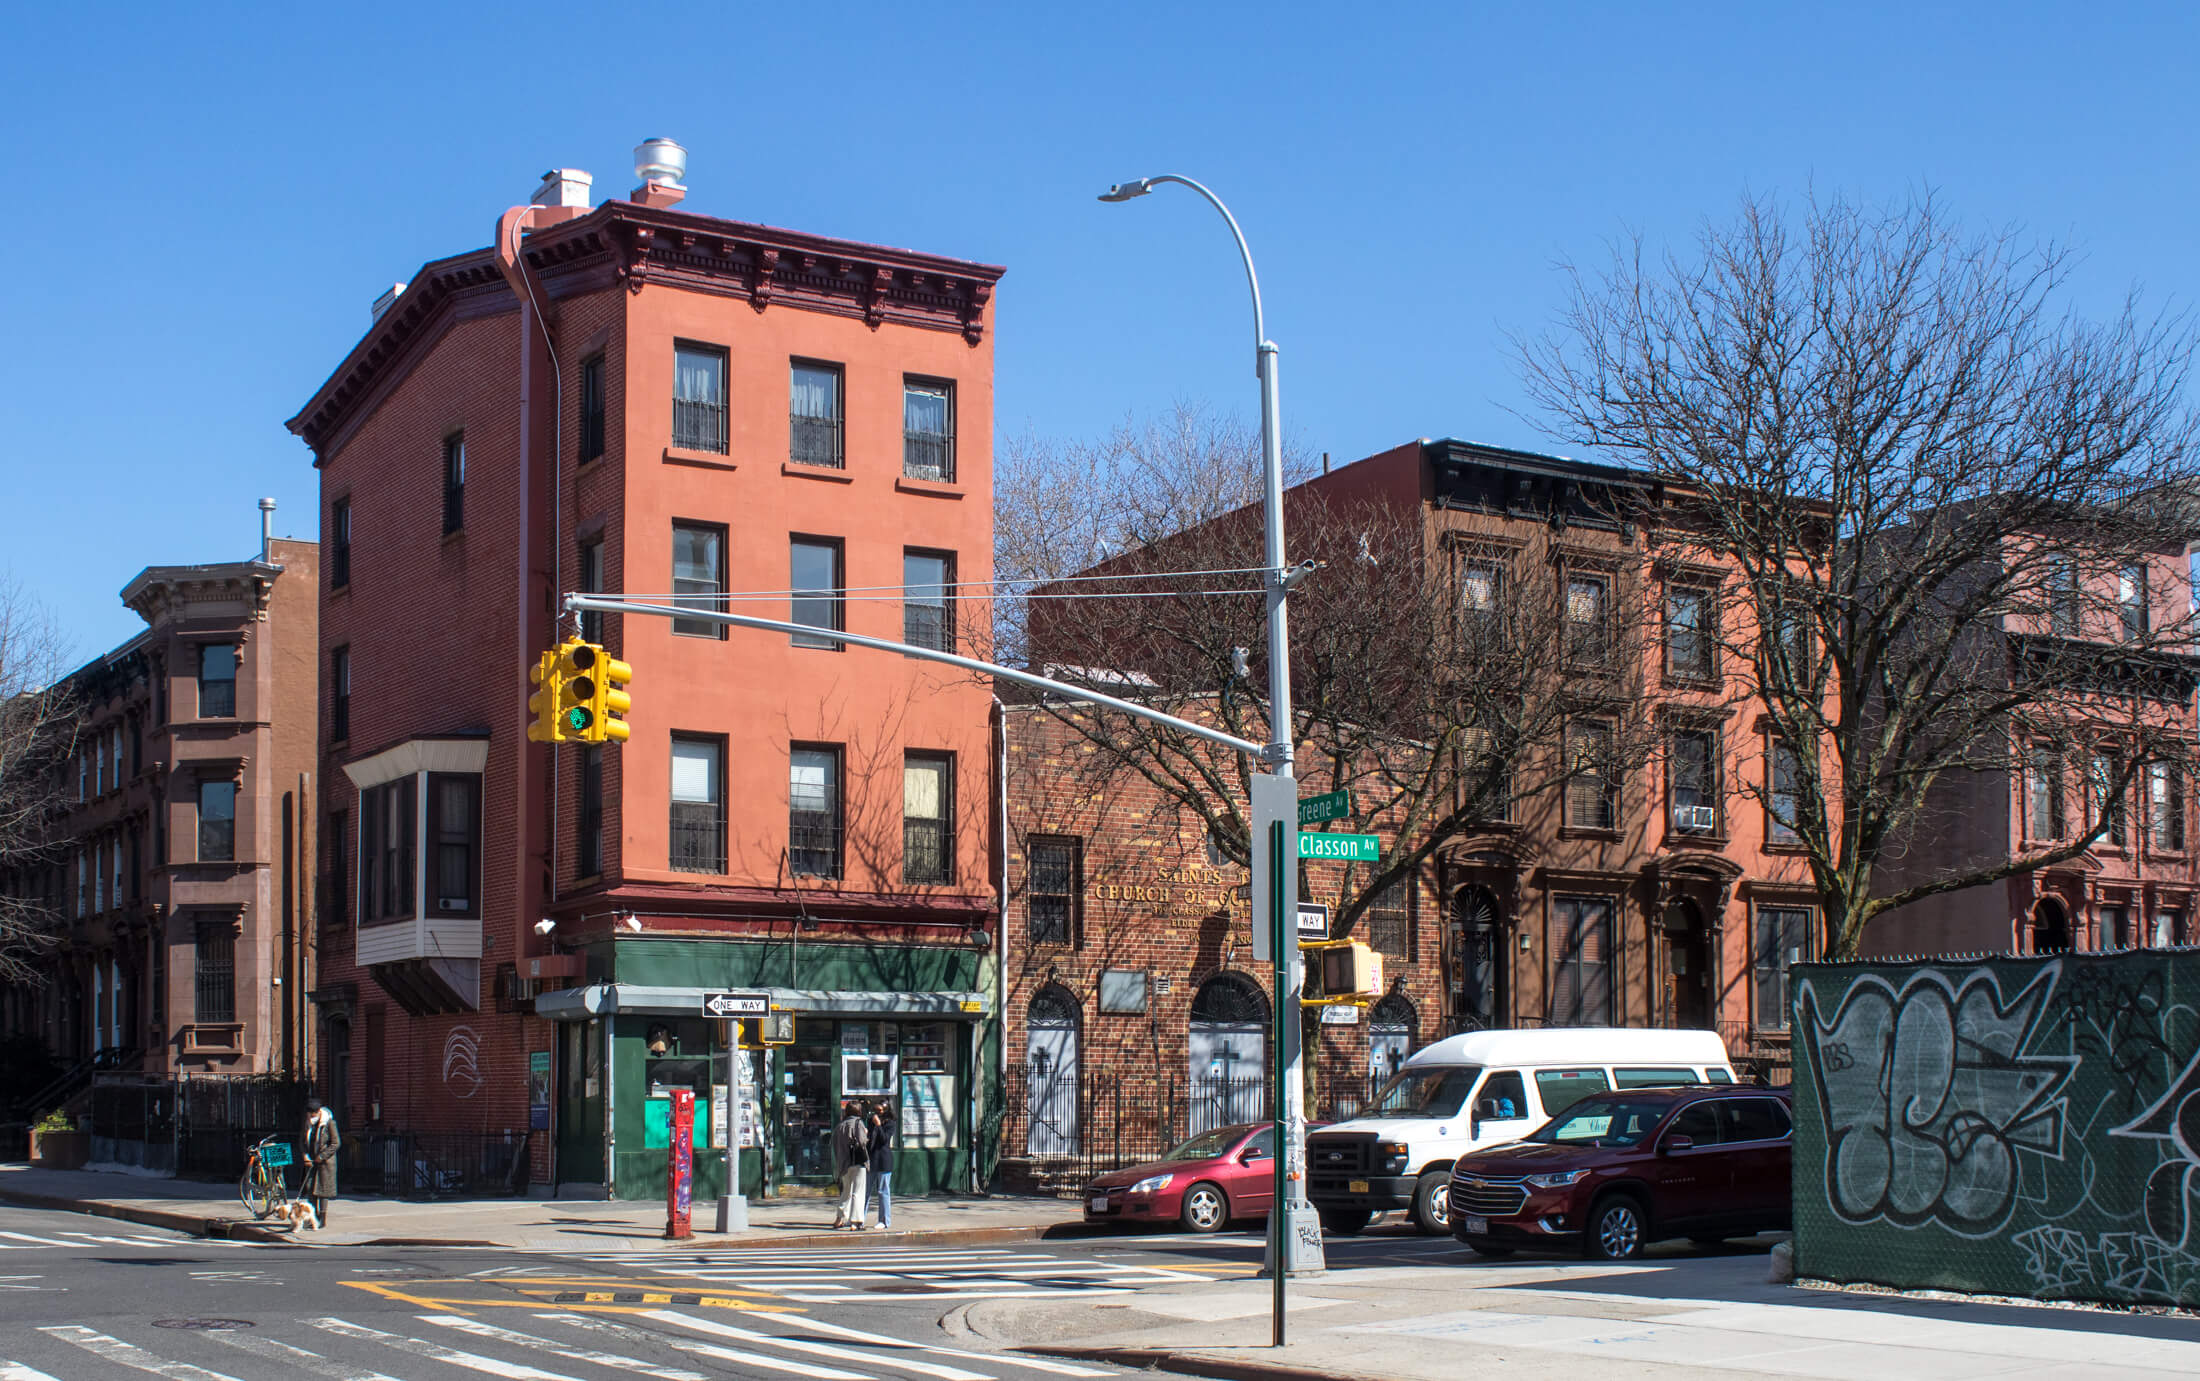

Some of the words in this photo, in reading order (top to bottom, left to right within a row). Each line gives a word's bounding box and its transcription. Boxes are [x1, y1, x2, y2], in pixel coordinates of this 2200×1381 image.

[1336, 796, 1344, 807] Av
[1301, 835, 1358, 856] Classon
[1364, 839, 1375, 850] Av
[1158, 867, 1222, 884] SAINTS
[1095, 885, 1170, 902] CHURCH
[1184, 888, 1206, 904] OF
[1172, 906, 1212, 918] CLASSON
[1303, 914, 1321, 927] WAY
[713, 1001, 733, 1009] ONE
[741, 1001, 761, 1010] WAY
